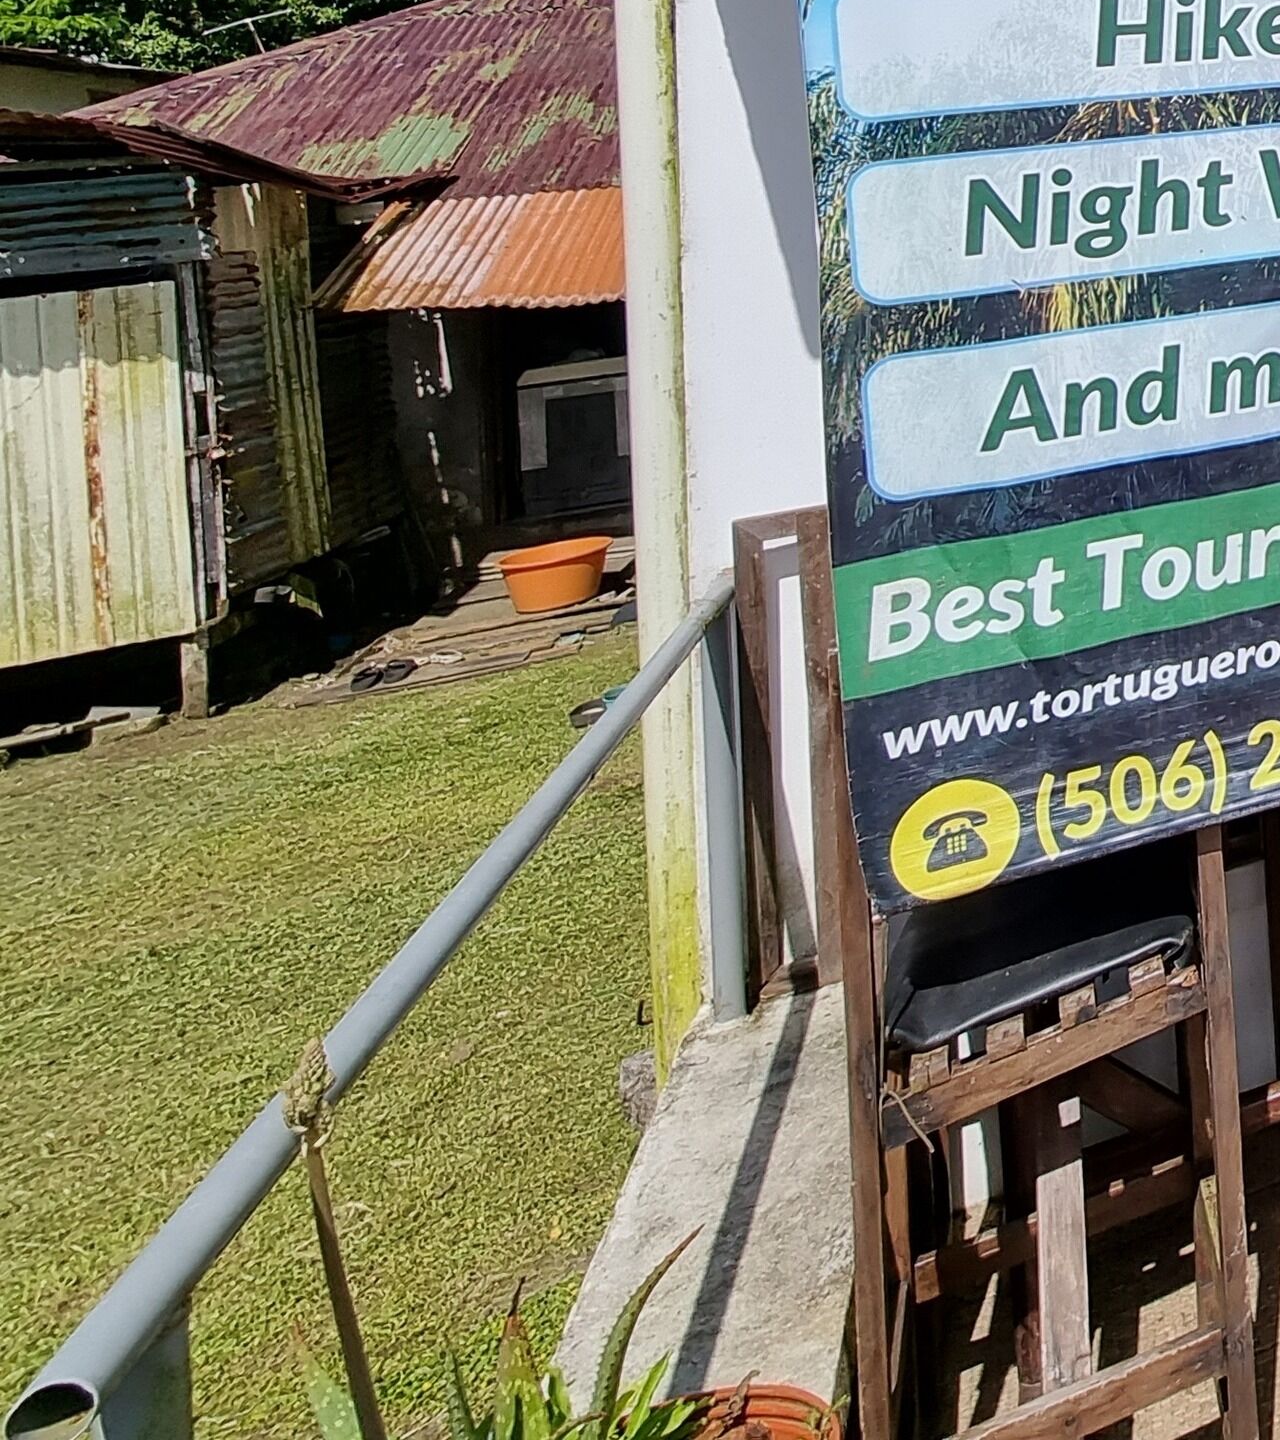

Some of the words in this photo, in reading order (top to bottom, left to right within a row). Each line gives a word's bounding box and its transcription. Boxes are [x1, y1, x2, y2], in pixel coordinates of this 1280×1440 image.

[964, 159, 1233, 259] Night
[980, 344, 1183, 453] And
[867, 565, 1066, 664] Best
[1035, 729, 1228, 861] (506)
